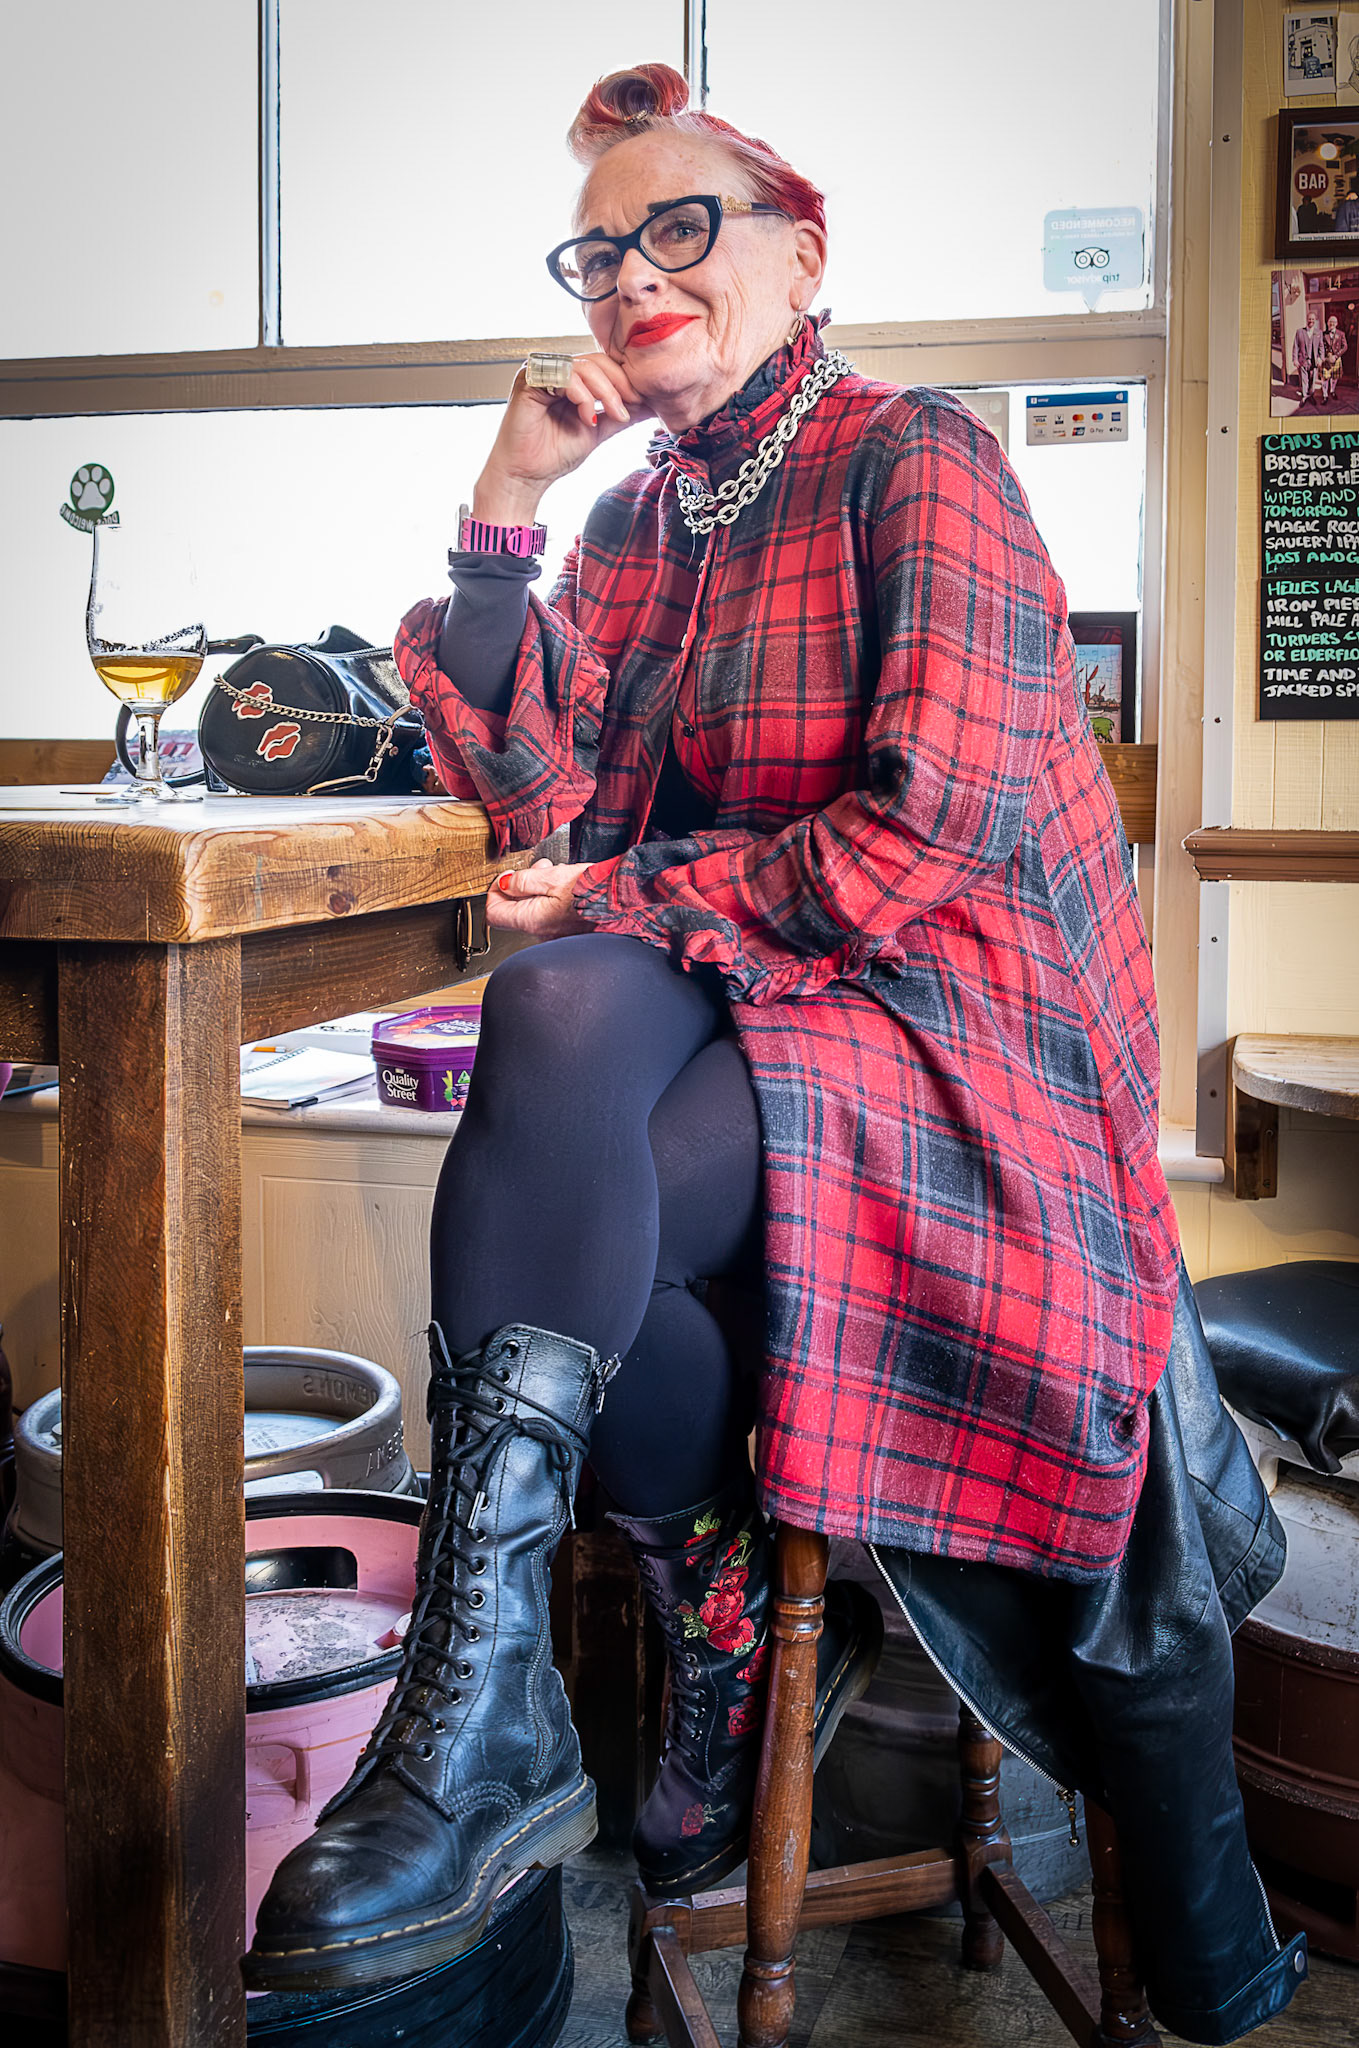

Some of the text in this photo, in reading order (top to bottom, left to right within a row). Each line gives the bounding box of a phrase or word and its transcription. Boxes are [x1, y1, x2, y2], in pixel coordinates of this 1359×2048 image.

[1299, 173, 1326, 189] BAR
[1328, 276, 1341, 290] 14
[1265, 434, 1322, 451] CANS
[1265, 454, 1343, 471] BRISTOL
[1265, 489, 1356, 506] WIPER AND
[1264, 505, 1348, 518] TOMORROW
[1265, 520, 1359, 533] MAGIC ROC
[1266, 534, 1333, 550] SAUCERY
[1266, 550, 1300, 564] LOST
[1268, 580, 1320, 596] HELLES
[1267, 598, 1317, 612] IRON
[1266, 615, 1303, 628] MILL
[1310, 611, 1347, 627] PALE
[1263, 650, 1286, 662] OR
[1263, 667, 1356, 682] TIME AND
[1263, 683, 1333, 697] JACKED
[382, 1070, 419, 1091] Quality
[387, 1084, 417, 1102] Street
